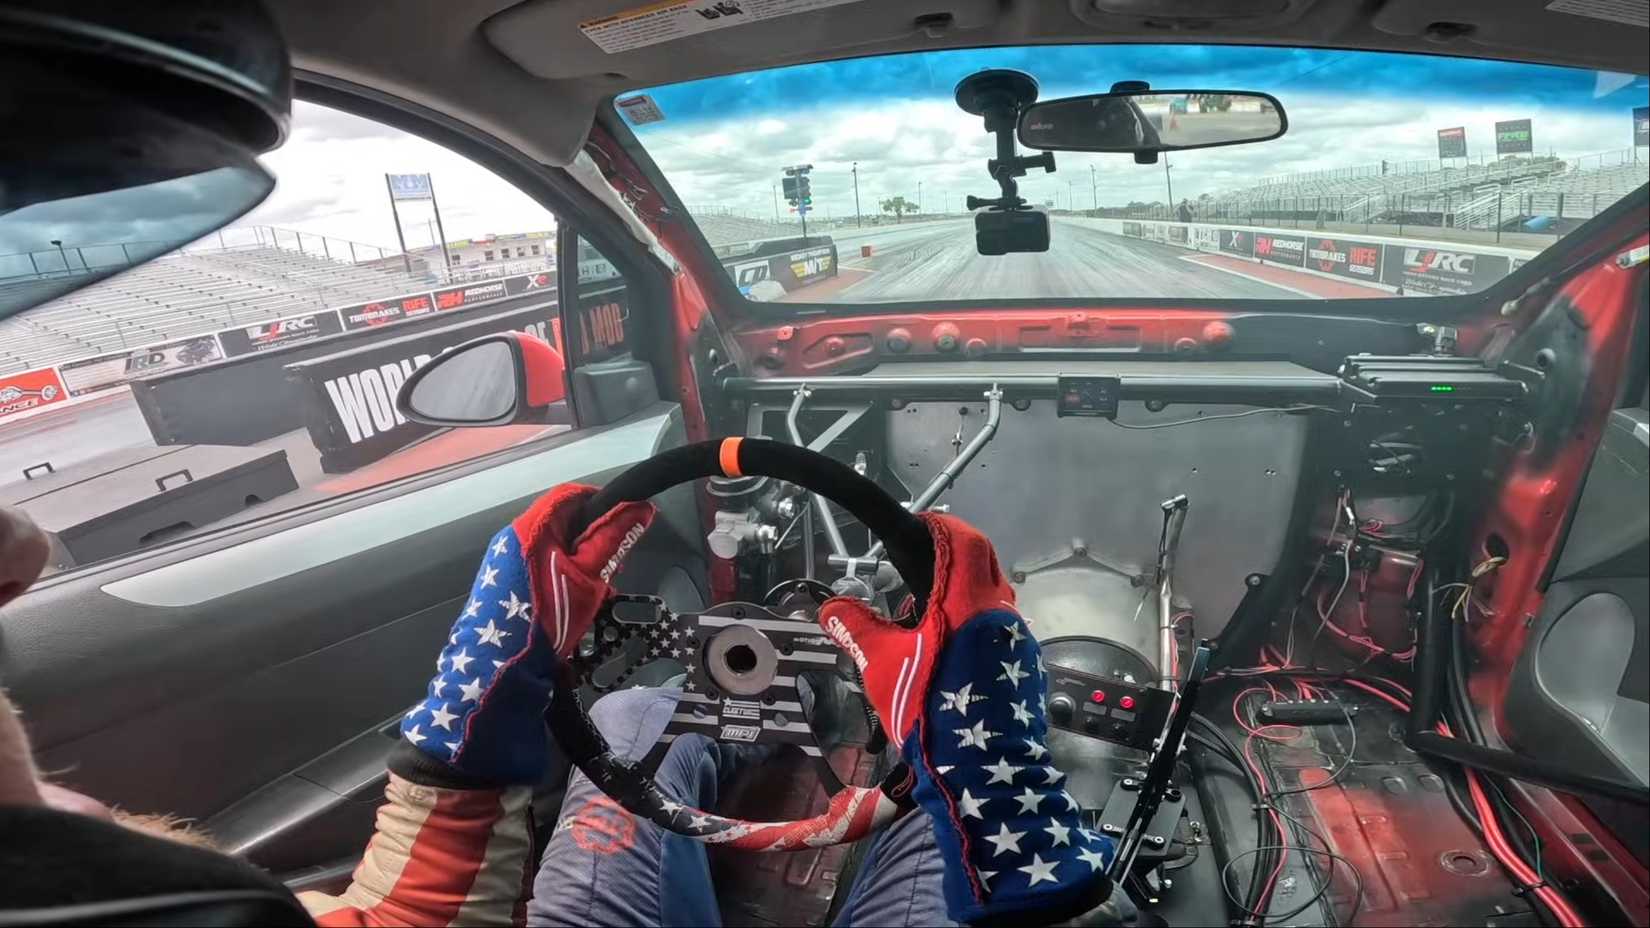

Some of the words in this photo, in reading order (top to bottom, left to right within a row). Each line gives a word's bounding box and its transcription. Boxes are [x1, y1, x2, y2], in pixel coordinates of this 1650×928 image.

[324, 354, 432, 444] WOR
[600, 522, 645, 584] SIMPSON
[825, 615, 869, 675] SIMPSON
